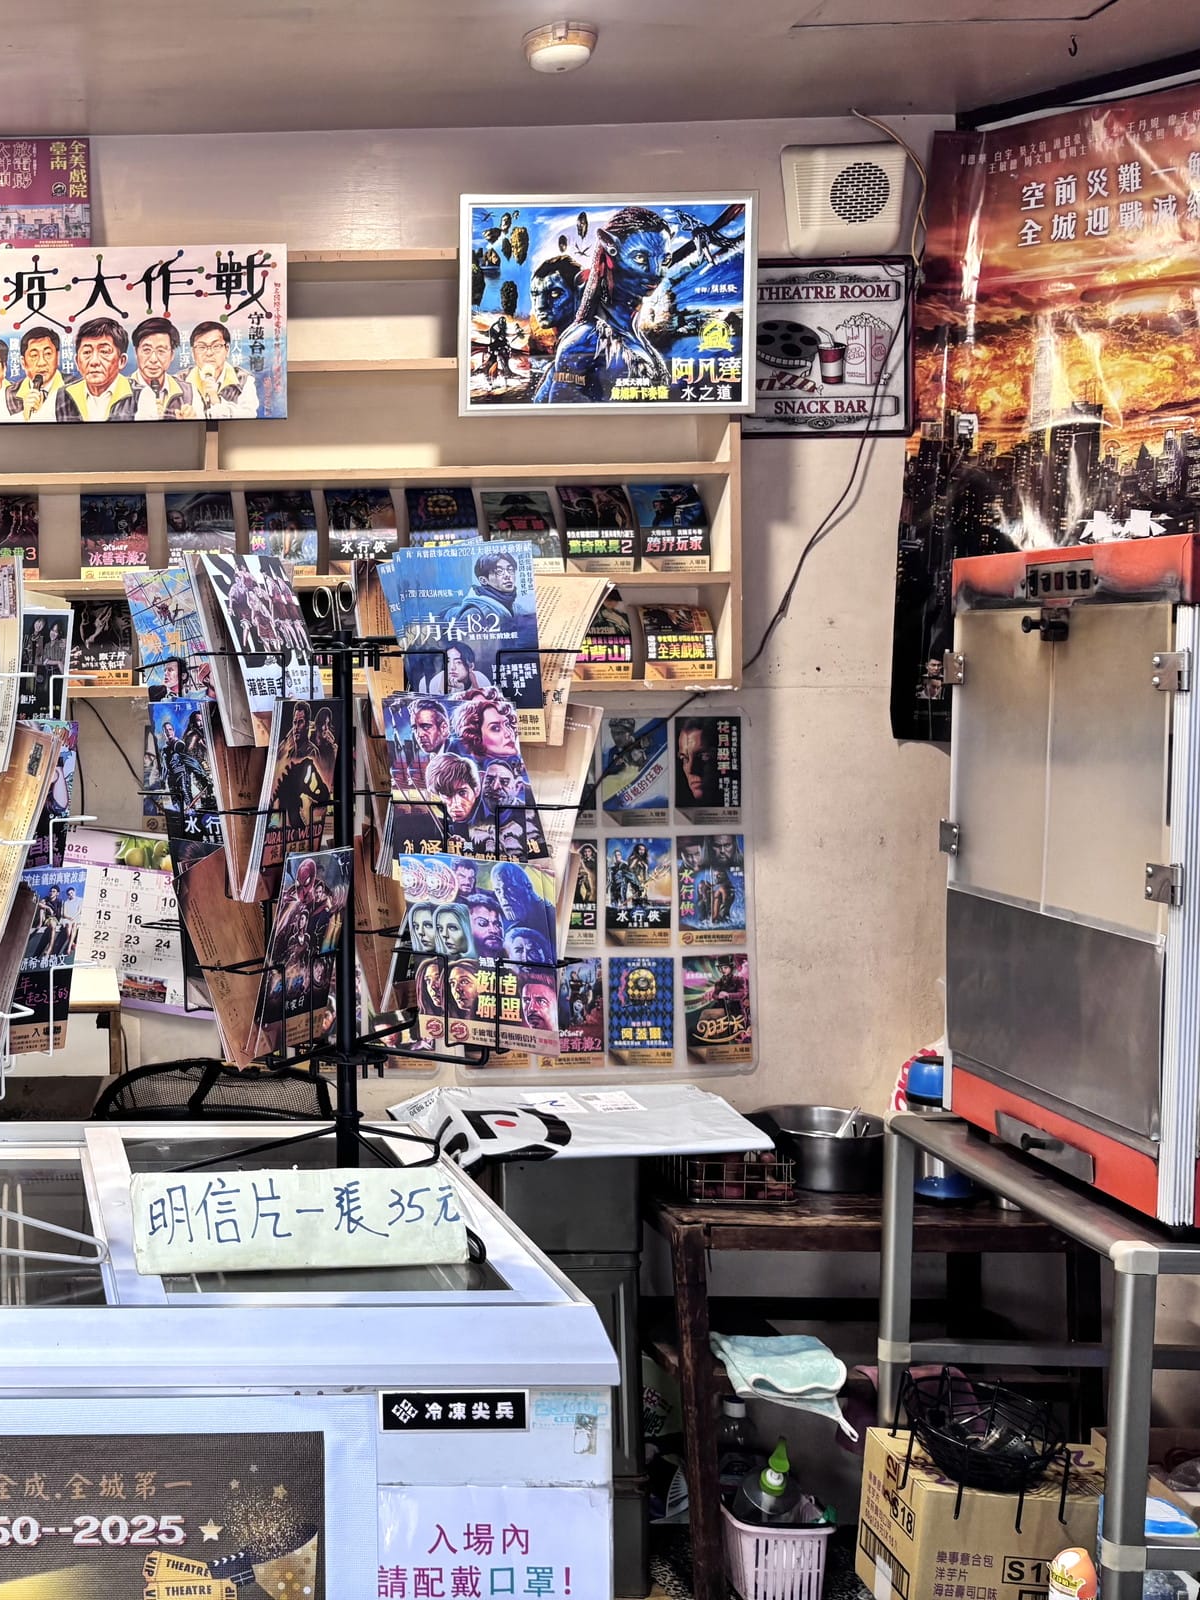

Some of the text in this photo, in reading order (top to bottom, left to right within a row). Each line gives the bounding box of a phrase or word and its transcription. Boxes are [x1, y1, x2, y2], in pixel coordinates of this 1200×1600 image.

[50, 142, 67, 171] 臺南
[69, 141, 87, 198] 全美戲院
[759, 284, 891, 300] THEATRE ROOM
[248, 312, 265, 372] 守護台灣
[671, 357, 742, 385] 阿凡達
[681, 385, 732, 401] 水之道
[774, 400, 868, 415] SNACK BAR
[341, 539, 387, 554] 水行俠
[646, 536, 703, 552] 跨界玩家
[658, 643, 705, 659] 全美戲院
[103, 868, 109, 877] 1
[133, 872, 141, 882] 2
[164, 876, 172, 885] 3
[99, 889, 107, 899] 8
[130, 893, 138, 903] 9
[680, 869, 695, 916] 水行俠
[161, 898, 176, 907] 10
[96, 910, 111, 921] 15
[127, 914, 142, 925] 16
[616, 909, 661, 923] 水行俠
[93, 931, 109, 941] 22
[125, 935, 140, 945] 23
[155, 939, 170, 949] 24
[91, 950, 106, 960] 29
[122, 954, 137, 964] 30
[148, 1177, 461, 1246] 明信片一張35元
[425, 1401, 514, 1420] 冷凍尖兵
[428, 1523, 529, 1555] 入場內
[144, 1557, 157, 1577] VIP
[165, 1559, 210, 1577] THEATRE
[935, 1567, 968, 1582] 洋芋片
[378, 1565, 571, 1598] 請配戴口罩!
[165, 1585, 212, 1596] THEATRE
